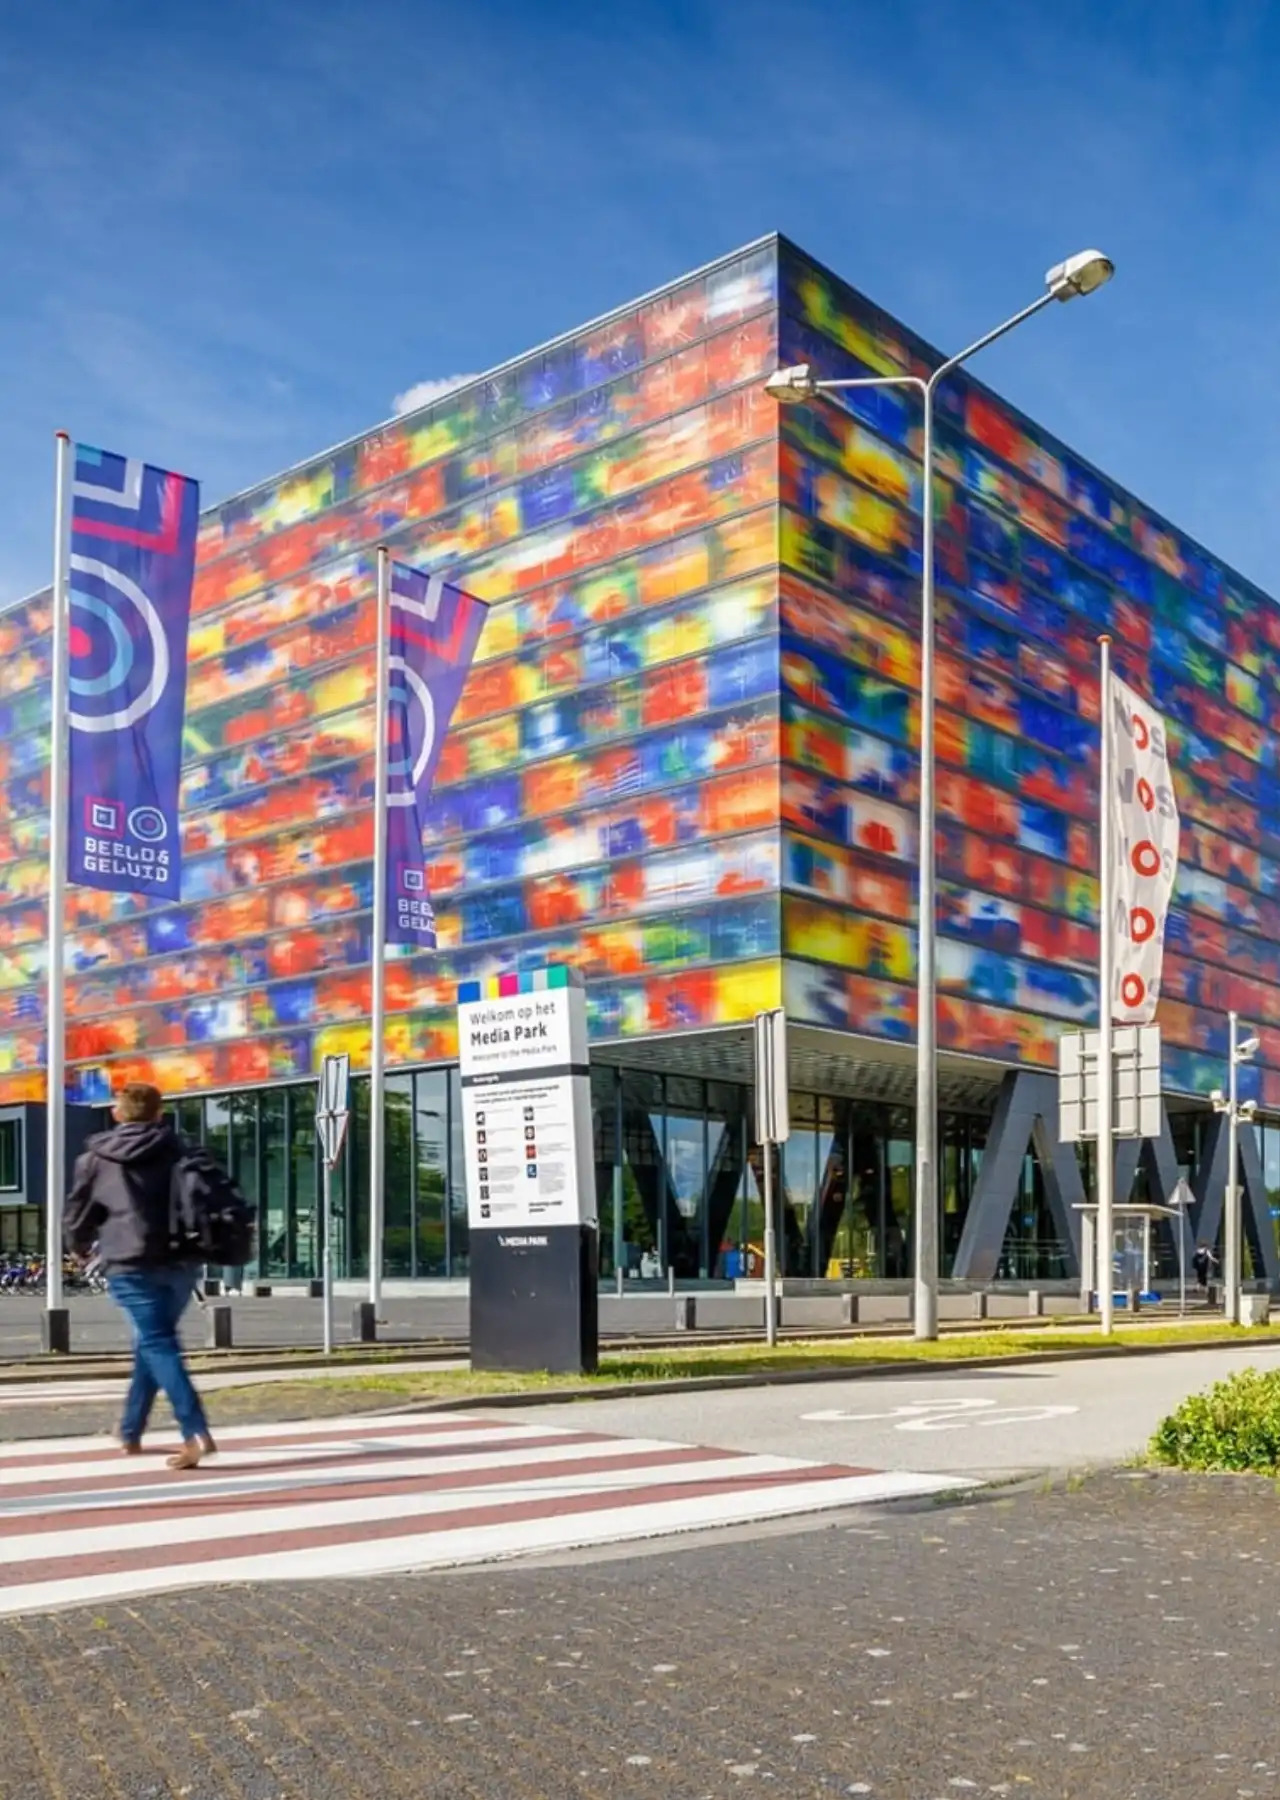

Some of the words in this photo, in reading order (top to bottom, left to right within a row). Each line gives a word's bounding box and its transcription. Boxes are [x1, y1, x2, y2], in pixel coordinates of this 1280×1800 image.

[84, 855, 169, 882] GELUID
[470, 1007, 515, 1025] Welkom
[517, 1007, 533, 1020] op
[535, 1001, 556, 1016] het
[471, 1028, 510, 1046] Media
[514, 1021, 547, 1041] Park
